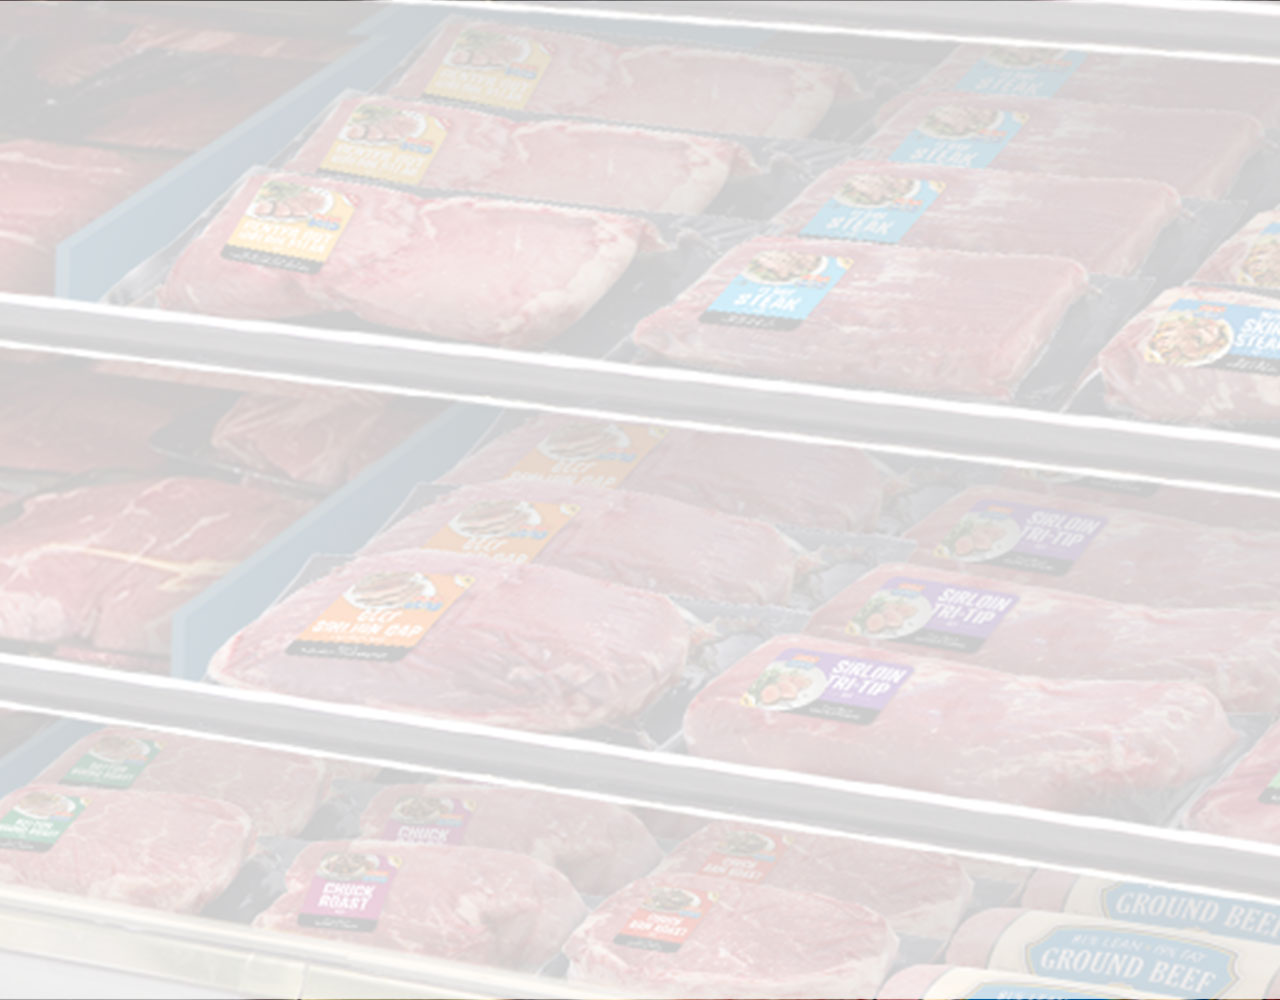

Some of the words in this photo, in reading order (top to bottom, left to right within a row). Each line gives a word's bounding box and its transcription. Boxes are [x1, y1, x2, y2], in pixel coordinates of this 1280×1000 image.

[826, 216, 895, 235] STEAK
[733, 293, 802, 312] STEAK
[1026, 511, 1101, 535] SIRLOIN
[1020, 526, 1085, 547] TRI-TIP
[937, 588, 1012, 612] SIRLOIN
[931, 603, 996, 625] TRI-TIP
[384, 625, 424, 638] CAP
[832, 659, 907, 684] SIRLOIN
[826, 675, 891, 697] TRI-TIP
[397, 825, 451, 842] CHUCK
[322, 882, 375, 899] CHUCK
[317, 894, 369, 911] ROAST
[1115, 892, 1219, 924] GROUND
[1040, 946, 1144, 980] GROUND
[1149, 963, 1217, 995] BEEF
